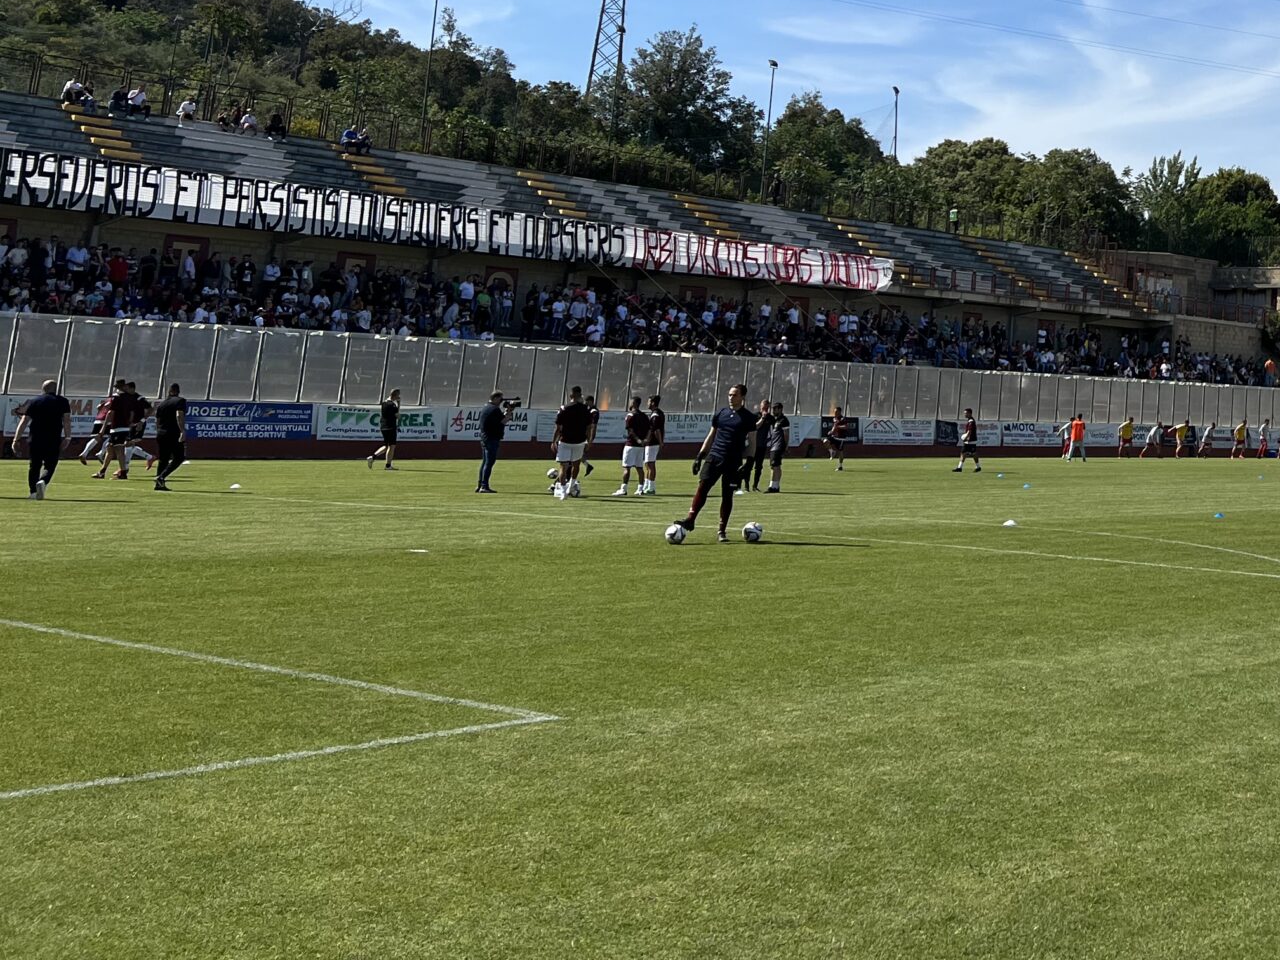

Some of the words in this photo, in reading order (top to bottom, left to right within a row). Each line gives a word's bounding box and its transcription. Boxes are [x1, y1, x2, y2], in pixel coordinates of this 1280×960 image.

[172, 169, 209, 224] ET
[488, 209, 515, 256] ET
[186, 406, 236, 417] UROBET
[245, 424, 274, 432] GIOCHI
[274, 424, 310, 432] VIRTUALI
[1012, 423, 1034, 432] MOTO
[249, 431, 287, 439] SPORTIVE
